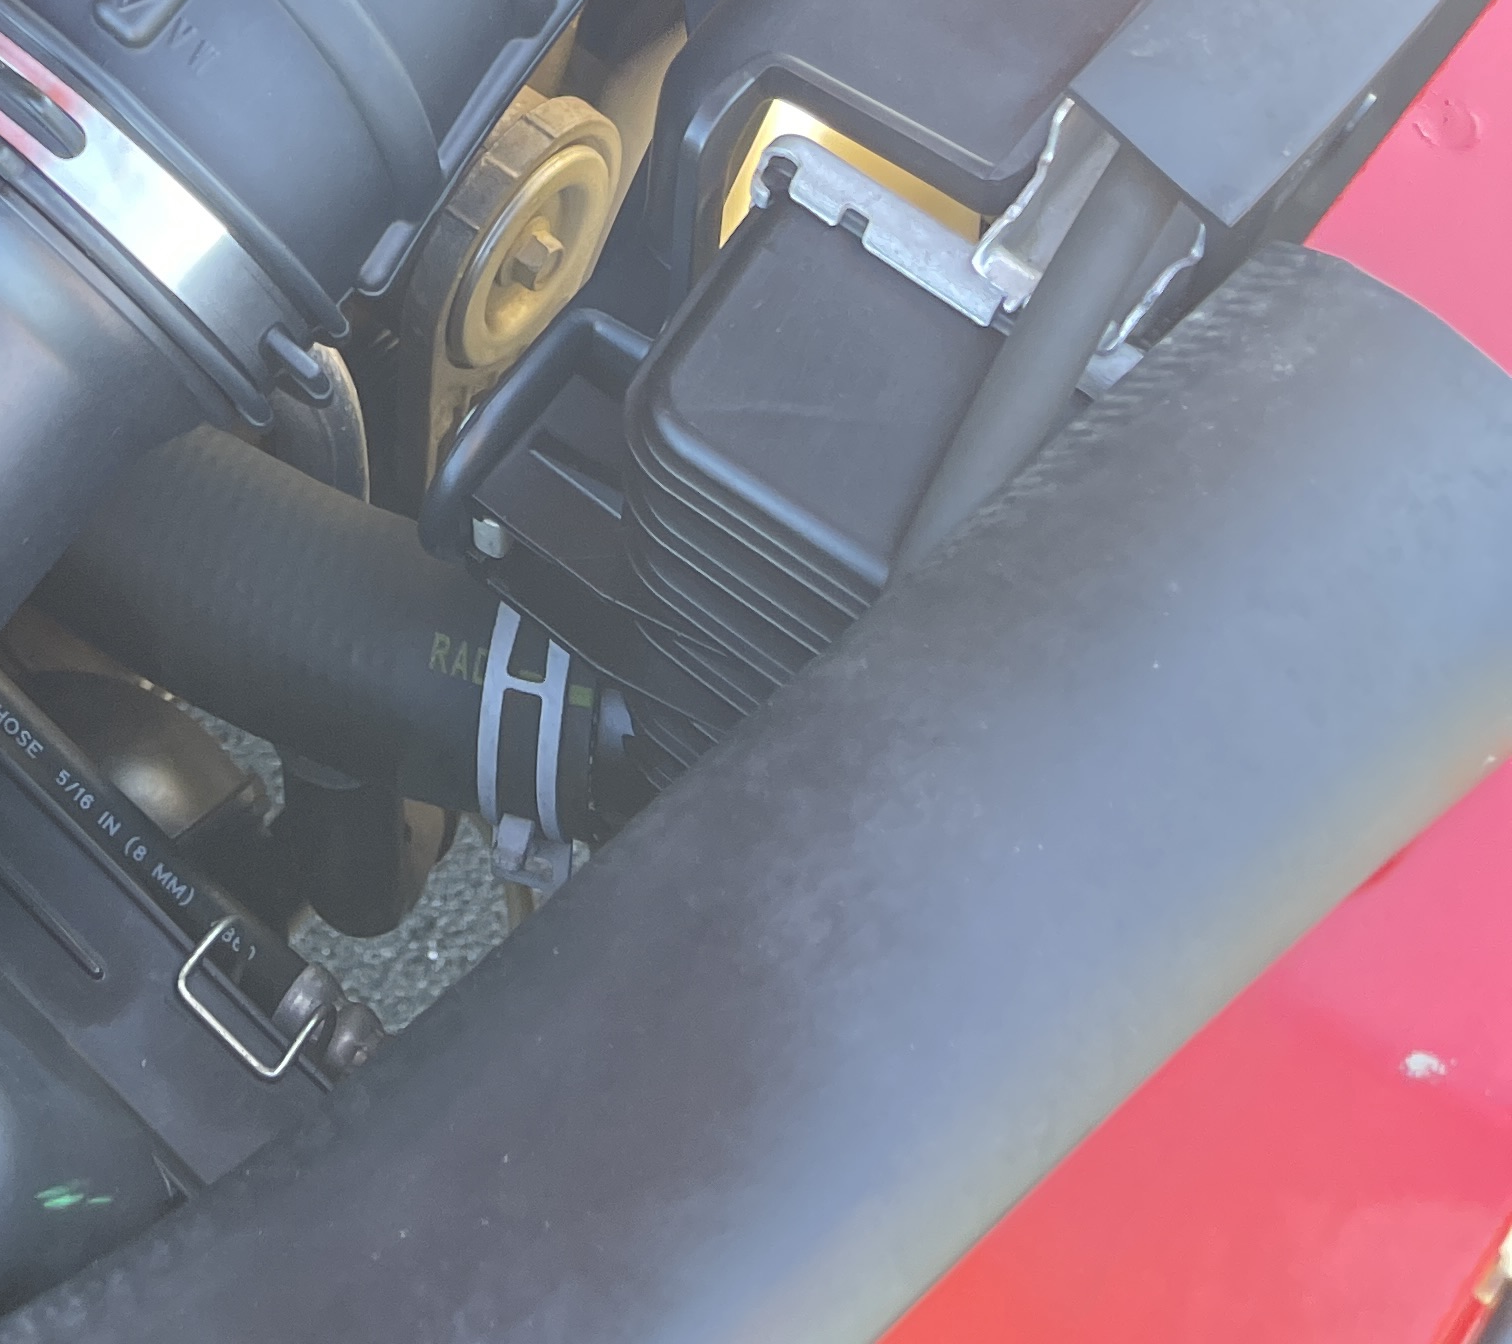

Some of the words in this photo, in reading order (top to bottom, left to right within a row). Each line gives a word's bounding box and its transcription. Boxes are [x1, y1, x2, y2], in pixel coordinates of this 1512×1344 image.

[55, 769, 95, 809] 5/16
[97, 811, 121, 837] IN
[124, 836, 148, 861] (8
[151, 863, 195, 906] MM)
